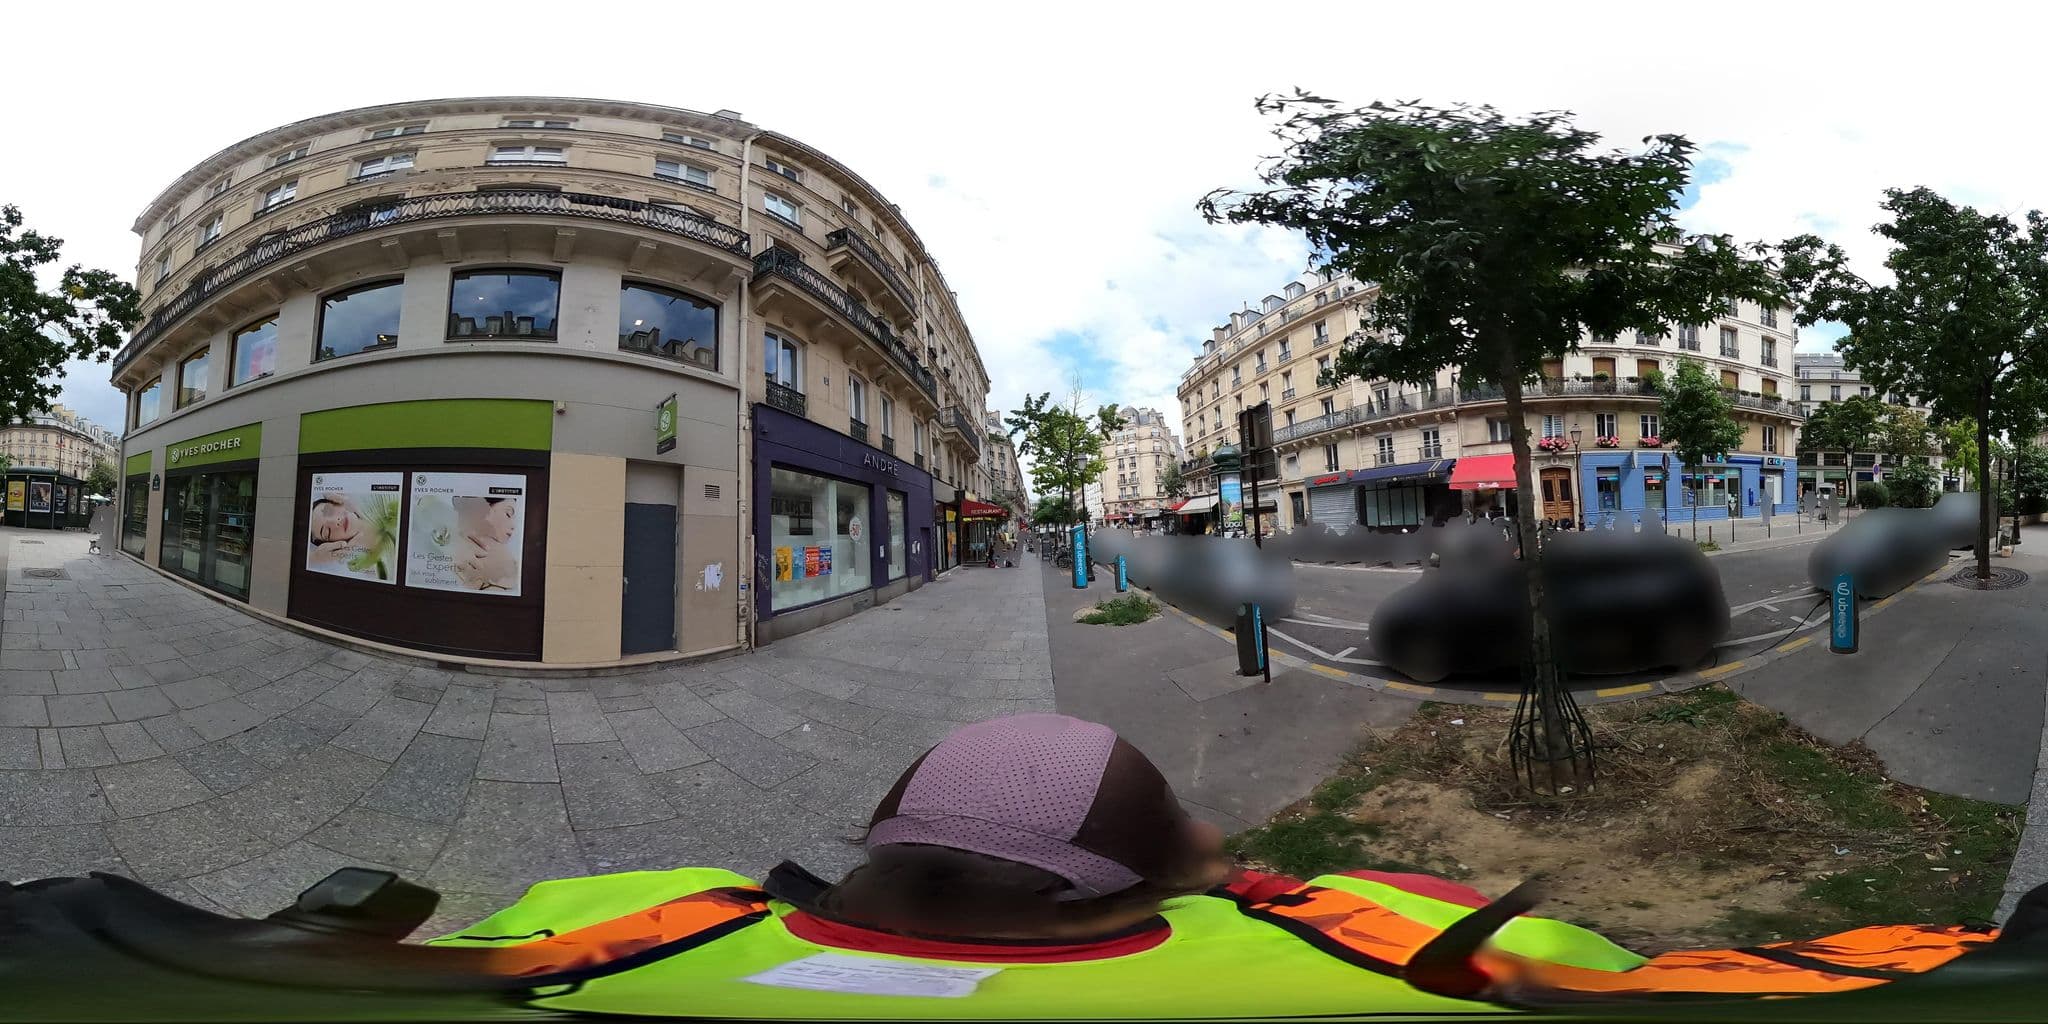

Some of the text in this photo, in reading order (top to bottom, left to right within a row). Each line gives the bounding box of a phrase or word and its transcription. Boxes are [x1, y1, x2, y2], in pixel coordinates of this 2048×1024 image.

[180, 438, 241, 457] YVES ROCHER
[864, 453, 898, 476] ANDRÉ
[413, 552, 453, 562] Les Gestes
